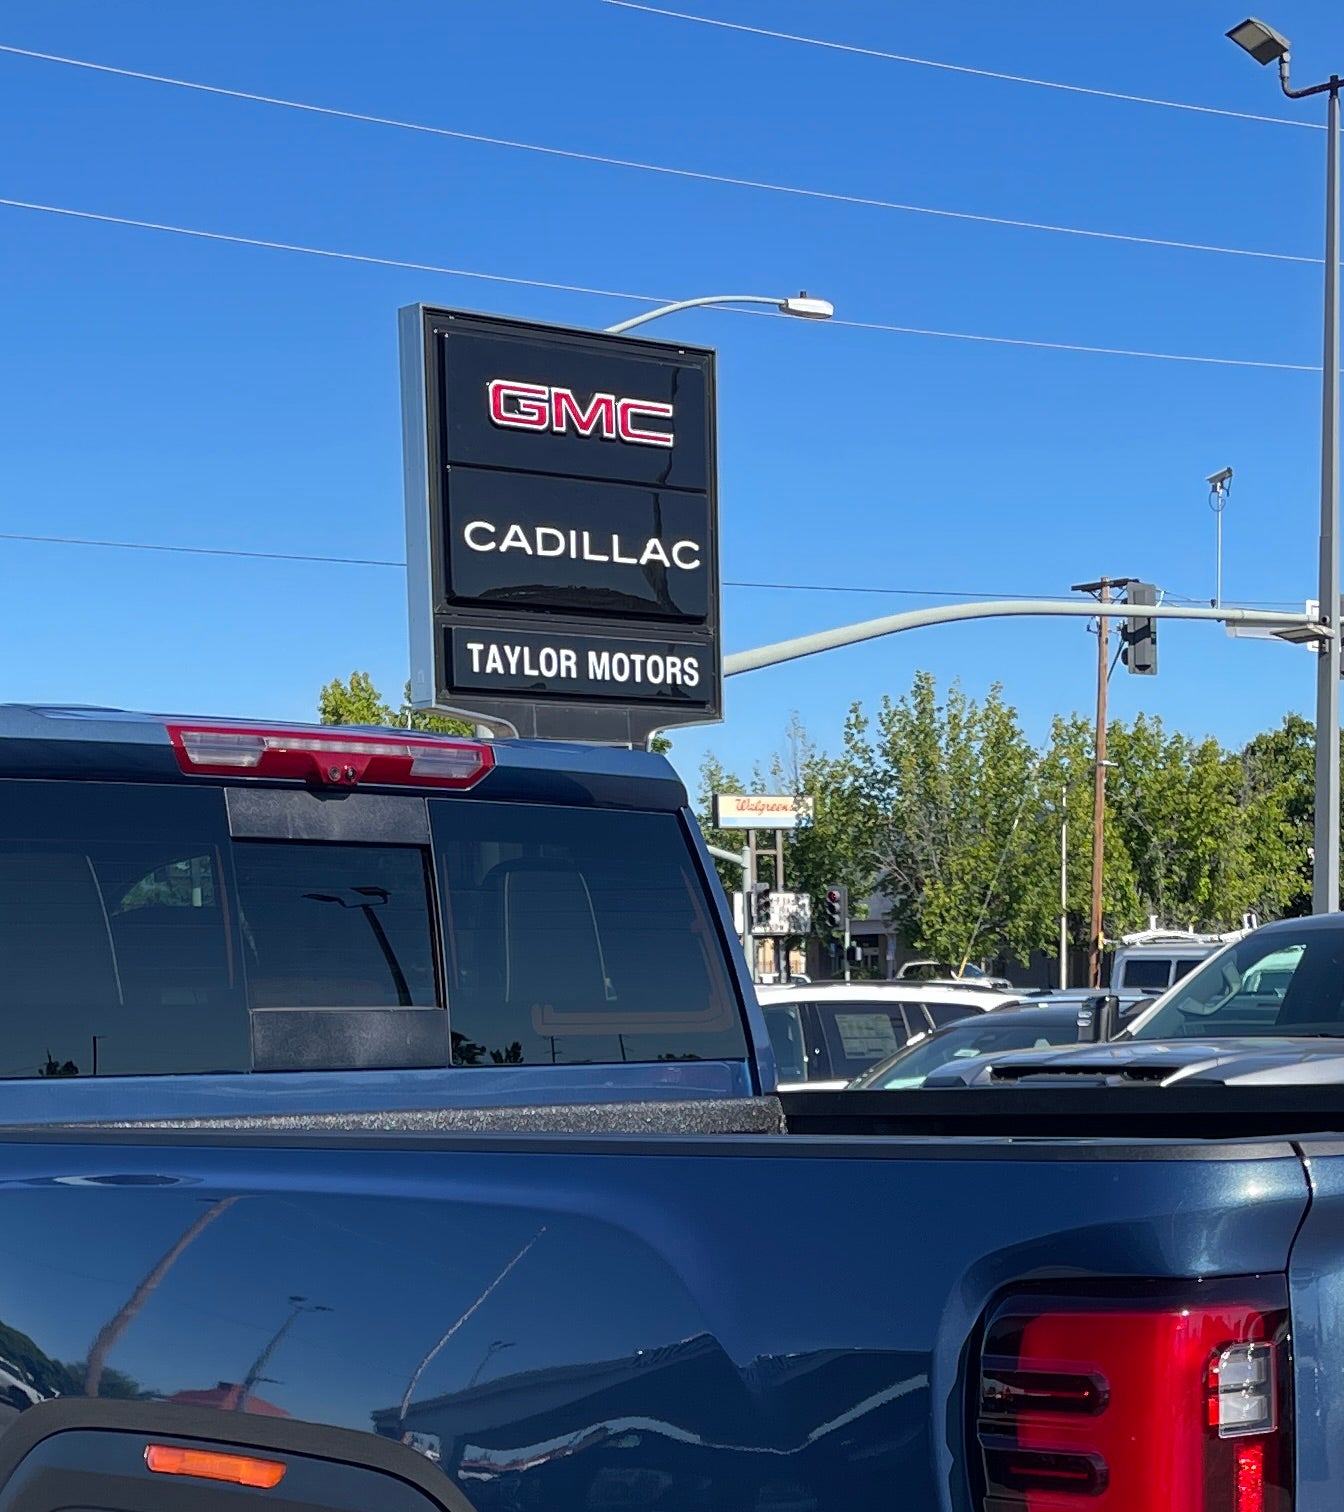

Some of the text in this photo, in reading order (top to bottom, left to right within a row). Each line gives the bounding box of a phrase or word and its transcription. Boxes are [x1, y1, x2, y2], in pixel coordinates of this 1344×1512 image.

[488, 378, 674, 448] GMC
[462, 520, 701, 570] CADILLAC
[466, 642, 700, 687] TAYLOR MOTORS
[735, 798, 798, 815] Walgreens
